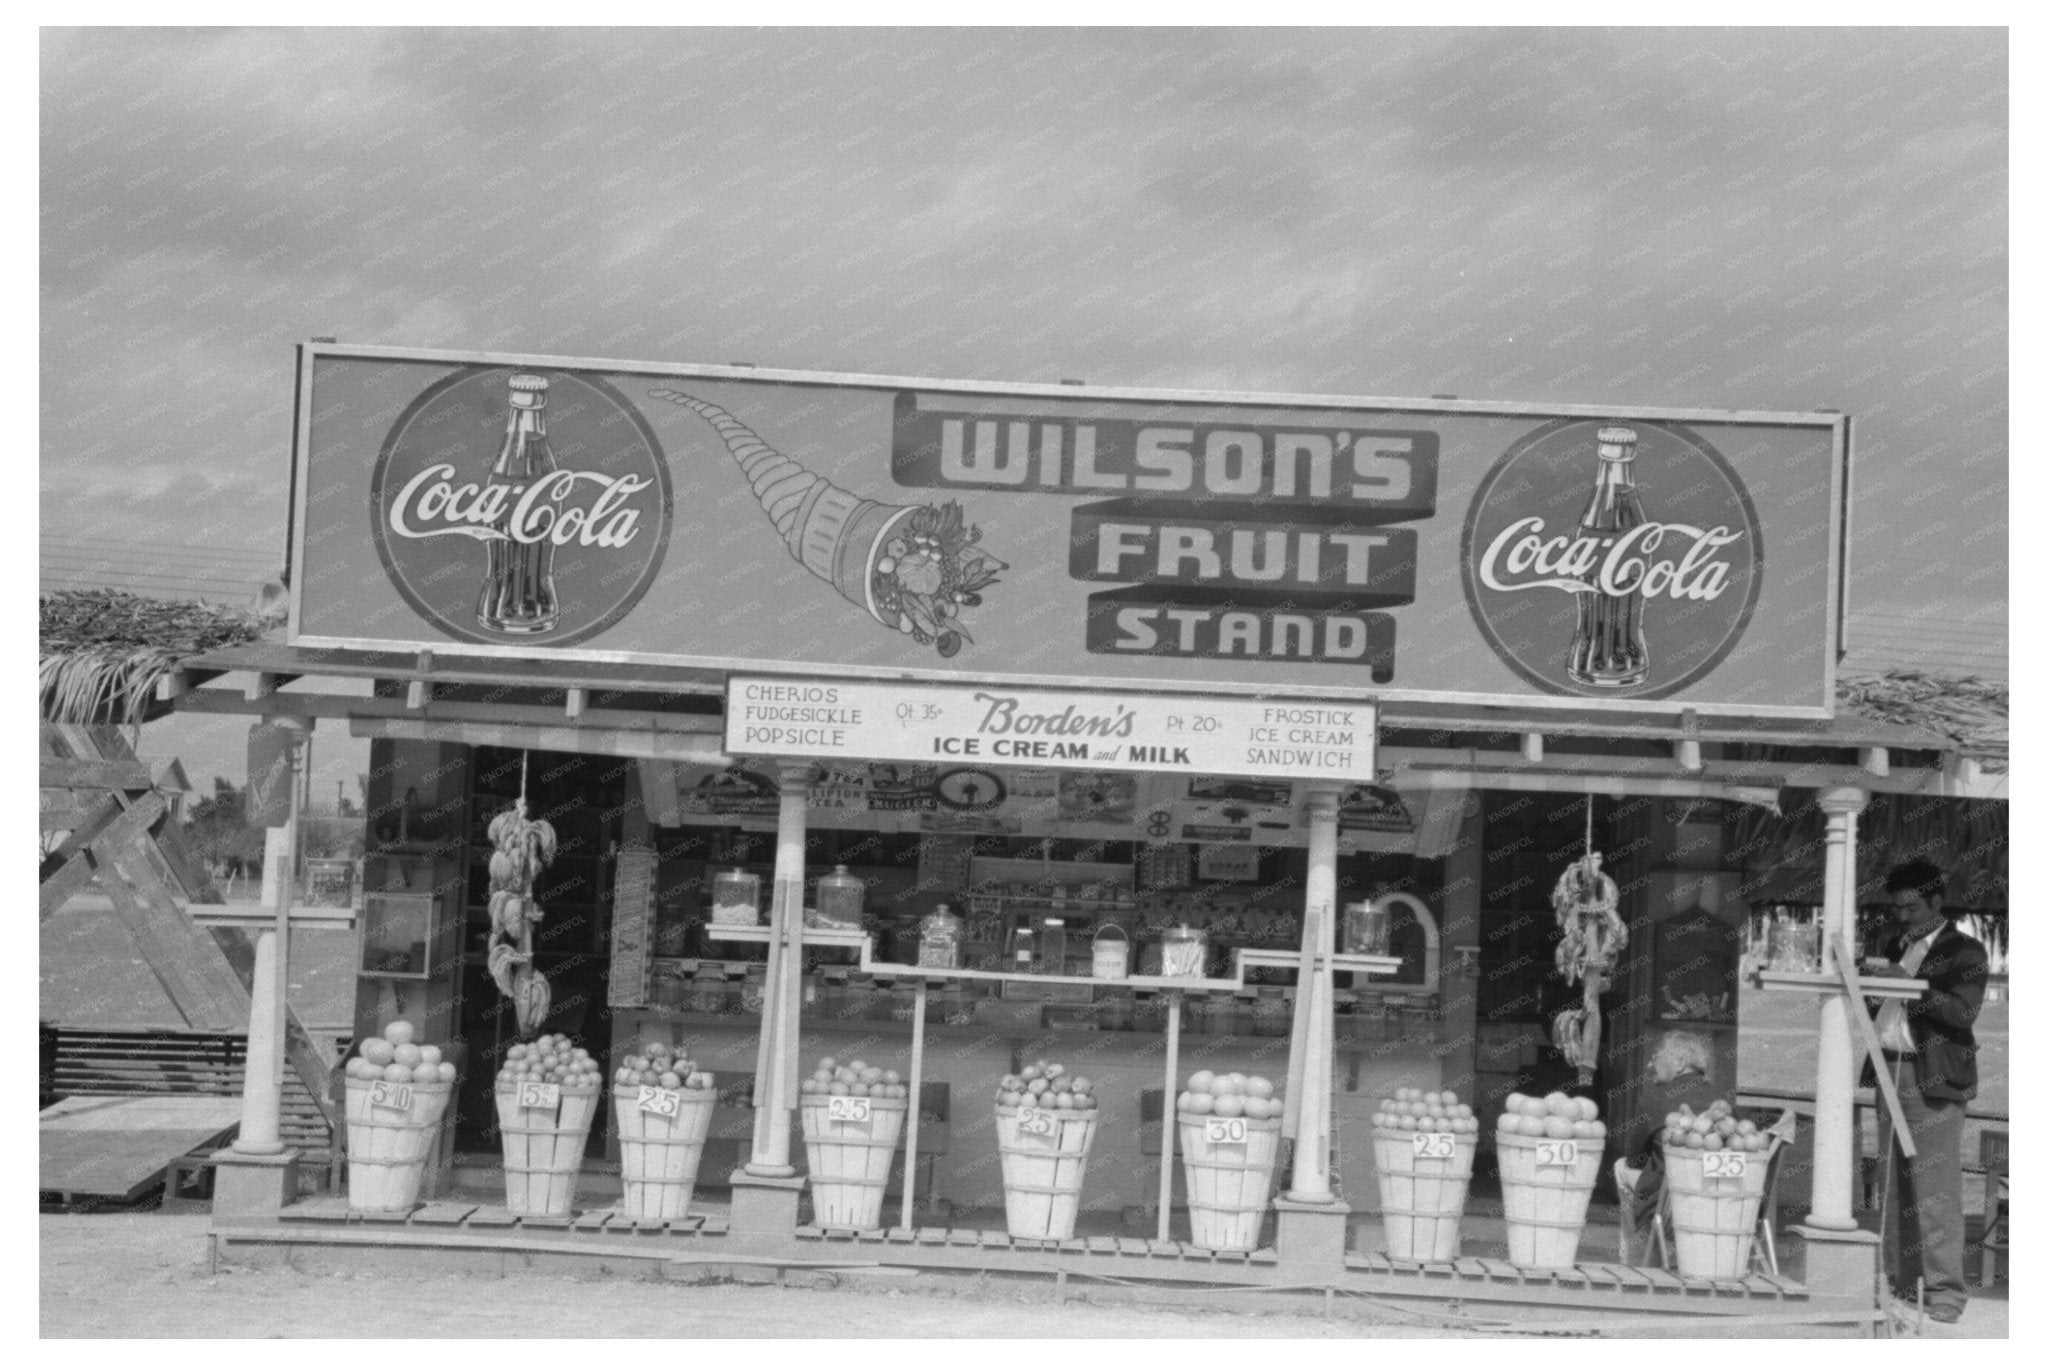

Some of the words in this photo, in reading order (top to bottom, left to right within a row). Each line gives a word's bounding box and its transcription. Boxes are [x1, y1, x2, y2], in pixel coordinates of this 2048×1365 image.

[941, 419, 1413, 501] WILSON'S
[390, 462, 654, 549] Coca-Cola
[1097, 522, 1388, 586] FRUIT
[1480, 516, 1743, 601] Coca-Cola
[1115, 607, 1367, 659] STAND
[746, 684, 839, 704] CHERIOS
[745, 705, 863, 725] FUDGESICKLE
[973, 692, 1137, 738] Borden's
[1263, 708, 1354, 726] FROSTICK
[745, 726, 845, 746] POPSICLE
[1248, 727, 1279, 743] ICE
[1288, 728, 1354, 746] CREAM
[933, 736, 980, 756] ICE
[992, 739, 1089, 760] CREAM
[1092, 745, 1122, 762] and
[1129, 746, 1191, 764] MILK
[1246, 748, 1353, 768] SANDWICH
[811, 787, 862, 799] LIPTON
[814, 797, 845, 808] TEA
[1018, 1108, 1052, 1134] 25
[1209, 1119, 1246, 1143] 30
[1537, 1142, 1576, 1165] 30
